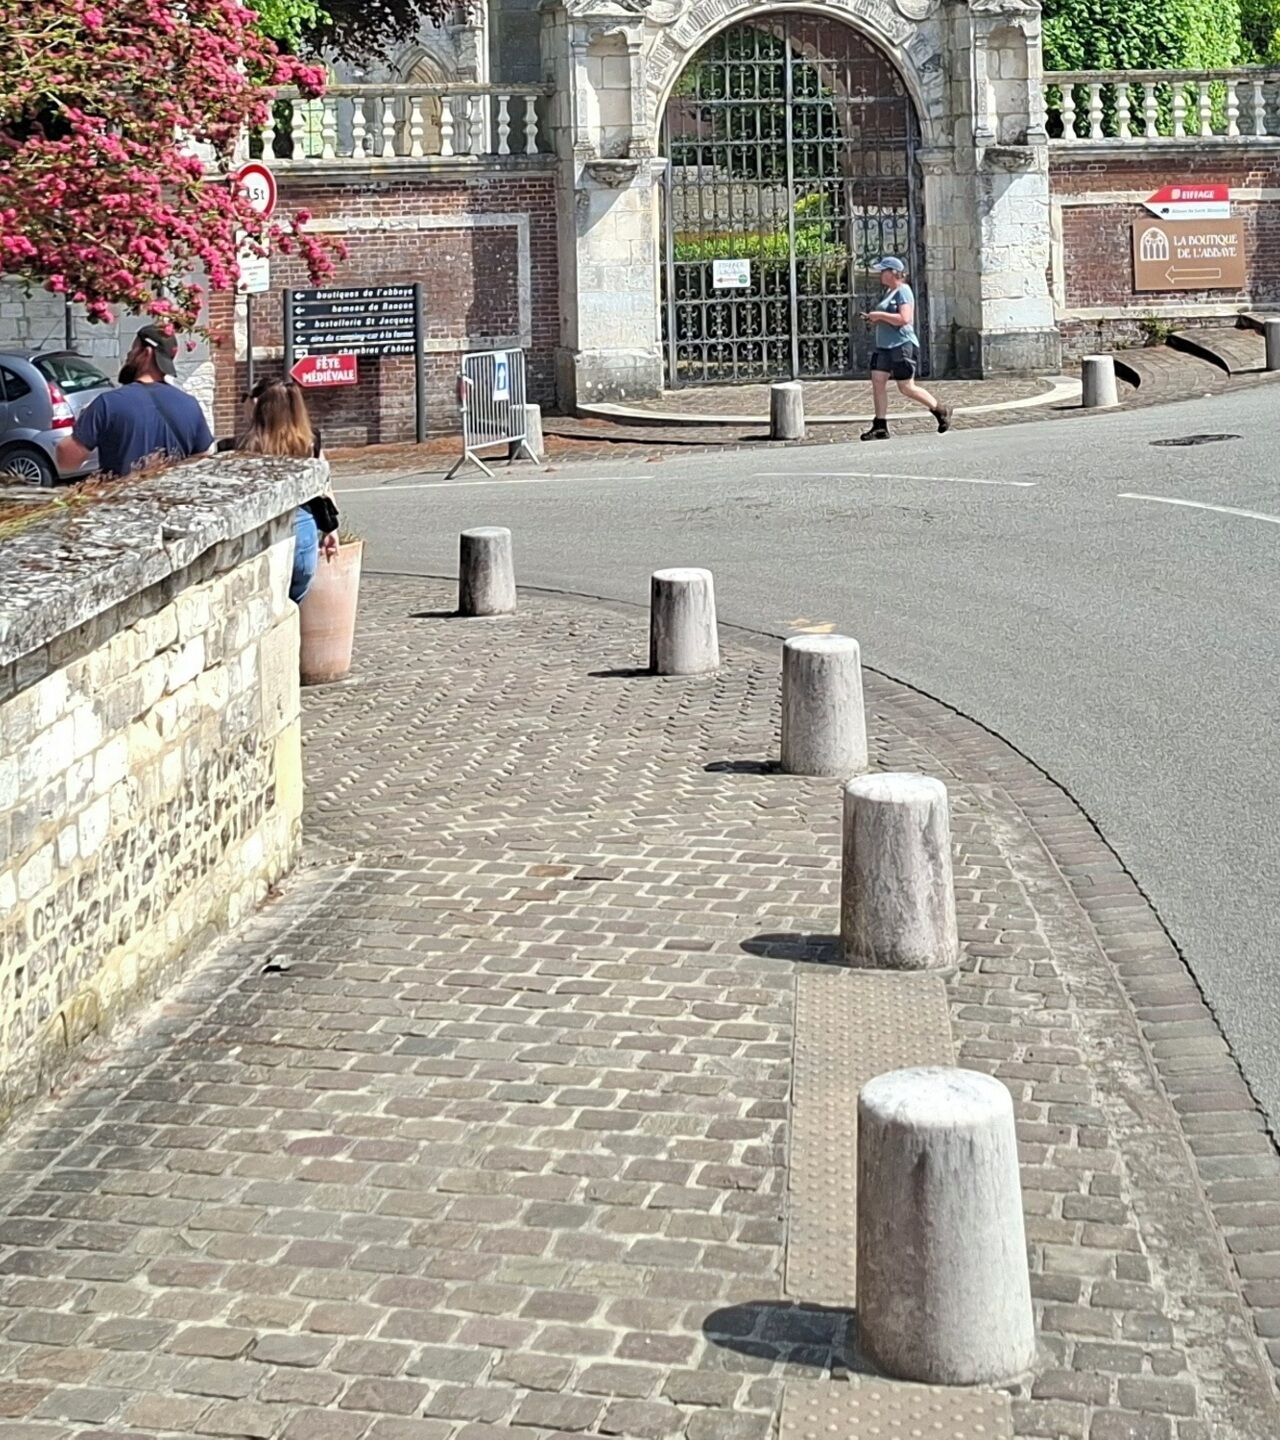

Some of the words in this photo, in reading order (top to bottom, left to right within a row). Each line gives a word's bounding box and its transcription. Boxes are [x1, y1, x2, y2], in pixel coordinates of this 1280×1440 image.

[1173, 235, 1187, 246] LA
[1188, 234, 1238, 246] BOUTIQUE
[1177, 247, 1191, 259] DE
[1193, 247, 1238, 258] L'ABBAYE
[316, 291, 359, 300] boutiques
[362, 289, 374, 297] de
[376, 288, 413, 297] l'abbaye
[331, 304, 365, 313] hameau
[368, 303, 379, 311] de
[314, 319, 362, 328] hostellerie
[365, 317, 375, 326] St
[378, 316, 414, 326] Jacques
[338, 346, 379, 355] chambres
[382, 345, 414, 353] d'hôtes
[316, 356, 340, 370] FÊTE
[302, 369, 355, 383] MÉDIÉVALE
